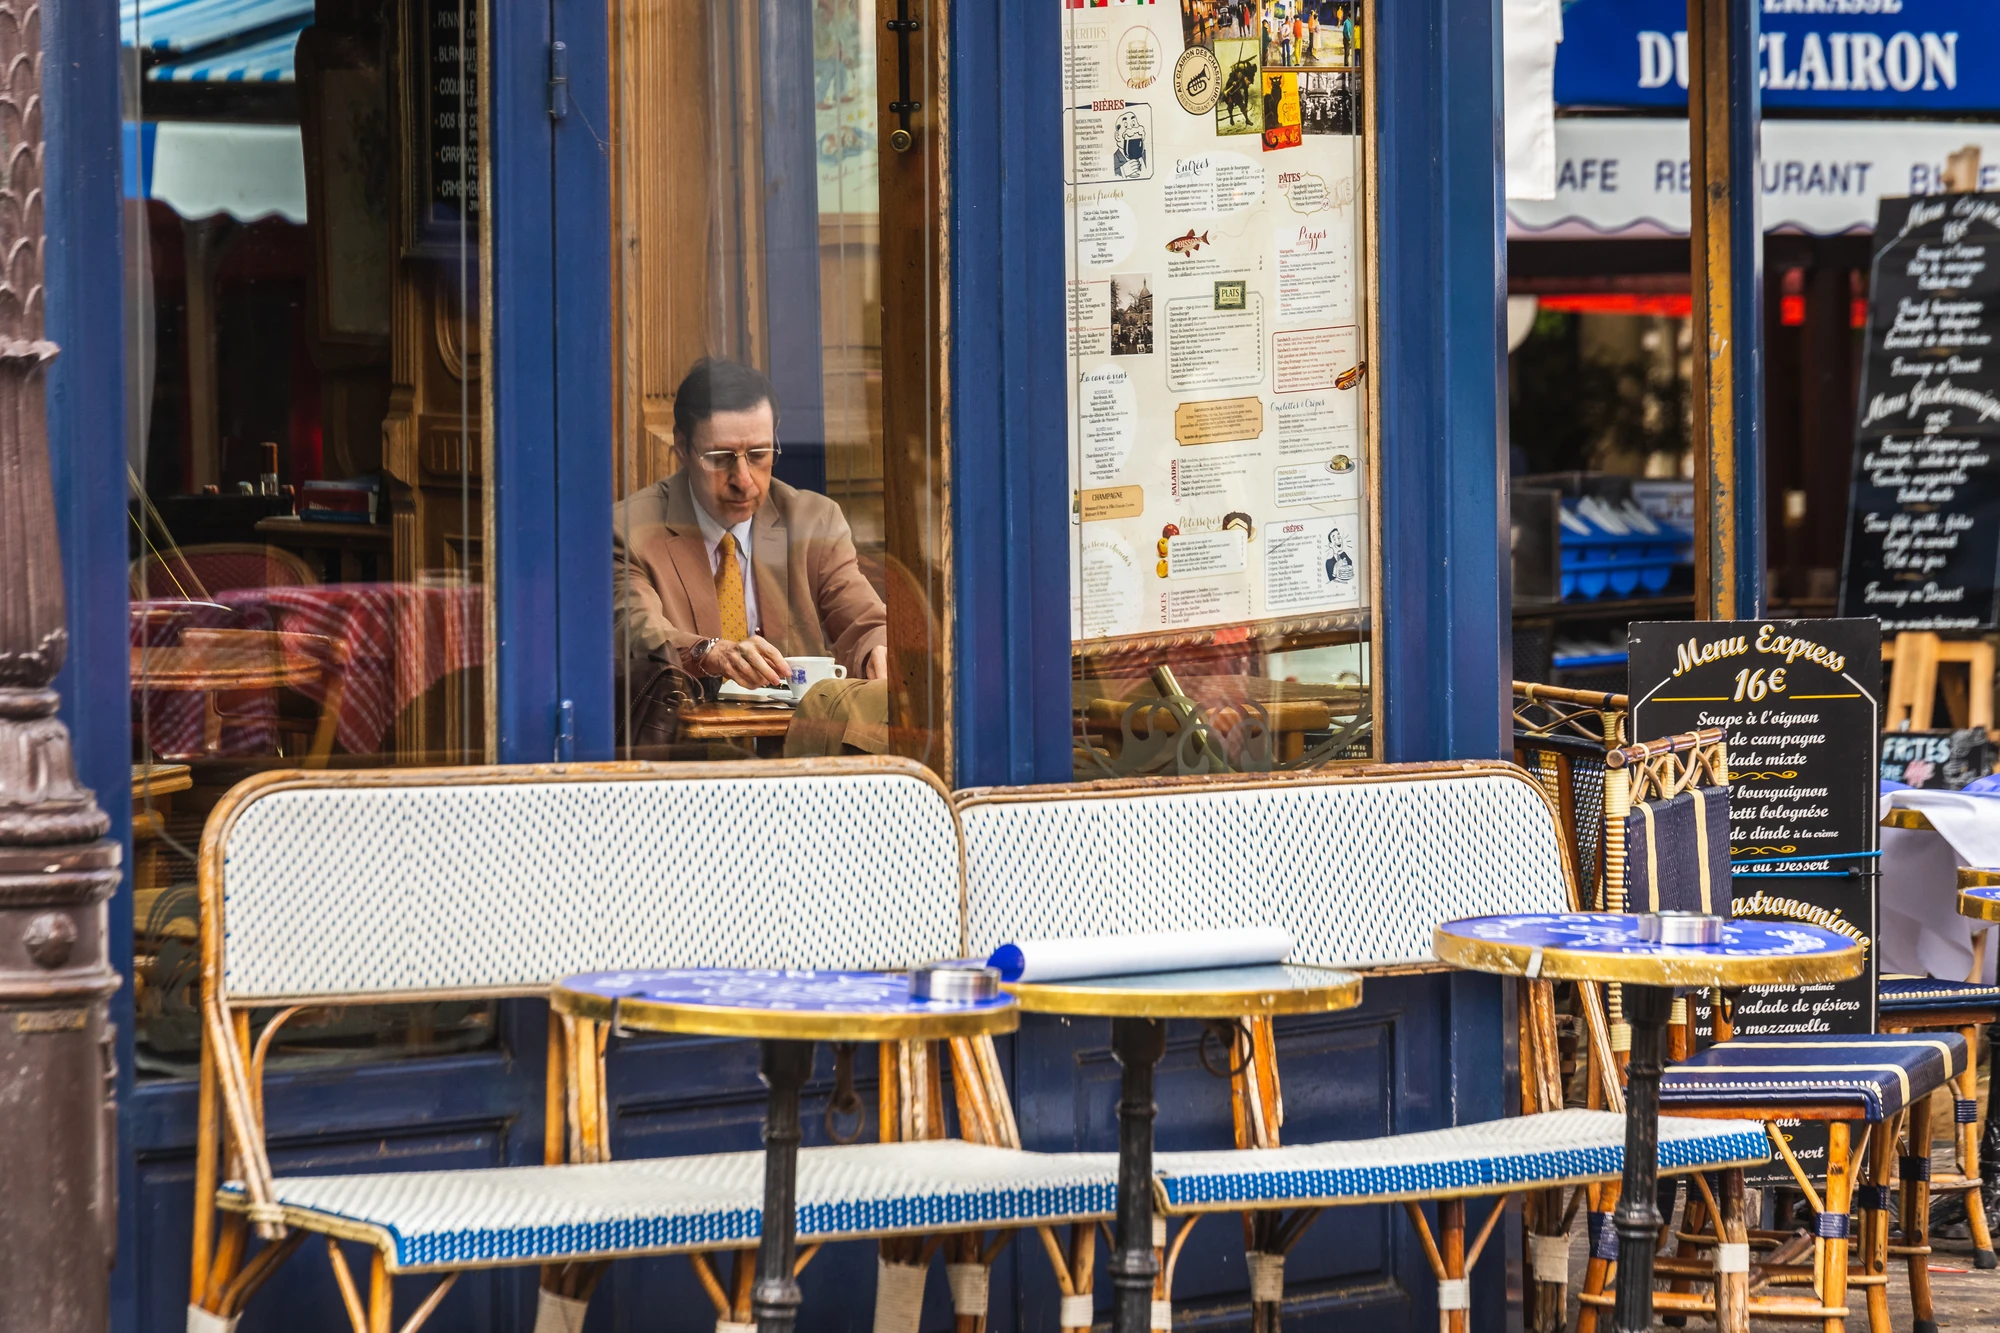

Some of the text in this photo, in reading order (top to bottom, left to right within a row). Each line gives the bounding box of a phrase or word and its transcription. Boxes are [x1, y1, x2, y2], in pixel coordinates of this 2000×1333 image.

[1176, 48, 1197, 81] CLAIRON
[1195, 48, 1208, 57] DES
[1637, 31, 1958, 91] DU LAIRON
[1126, 74, 1157, 89] Cocktails
[1092, 98, 1125, 112] BIÈRES
[1179, 93, 1213, 113] RESTAURANT
[1278, 172, 1301, 184] PÂTES
[1556, 159, 1618, 192] AFE
[1654, 160, 1874, 194] REURANT
[1222, 288, 1240, 298] PLATS
[1092, 492, 1124, 501] CHAMPAGNE
[1283, 524, 1304, 534] CRÊPES
[1672, 623, 1846, 678] Menu Express
[1733, 667, 1787, 703] 16€
[1696, 710, 1820, 729] Soupe à l'oignon
[1729, 731, 1826, 750] de campagne
[1725, 751, 1808, 767] lade mixte
[1736, 785, 1828, 804] bourguignon
[1730, 825, 1839, 840] de dinde à la crème
[1752, 862, 1772, 872] ou
[1775, 858, 1830, 872] Dessert
[1731, 890, 1871, 947] astronomique
[1799, 982, 1836, 994] gratinée
[1738, 997, 1860, 1016] salade de gésiers
[1745, 1018, 1830, 1036] mozzarella
